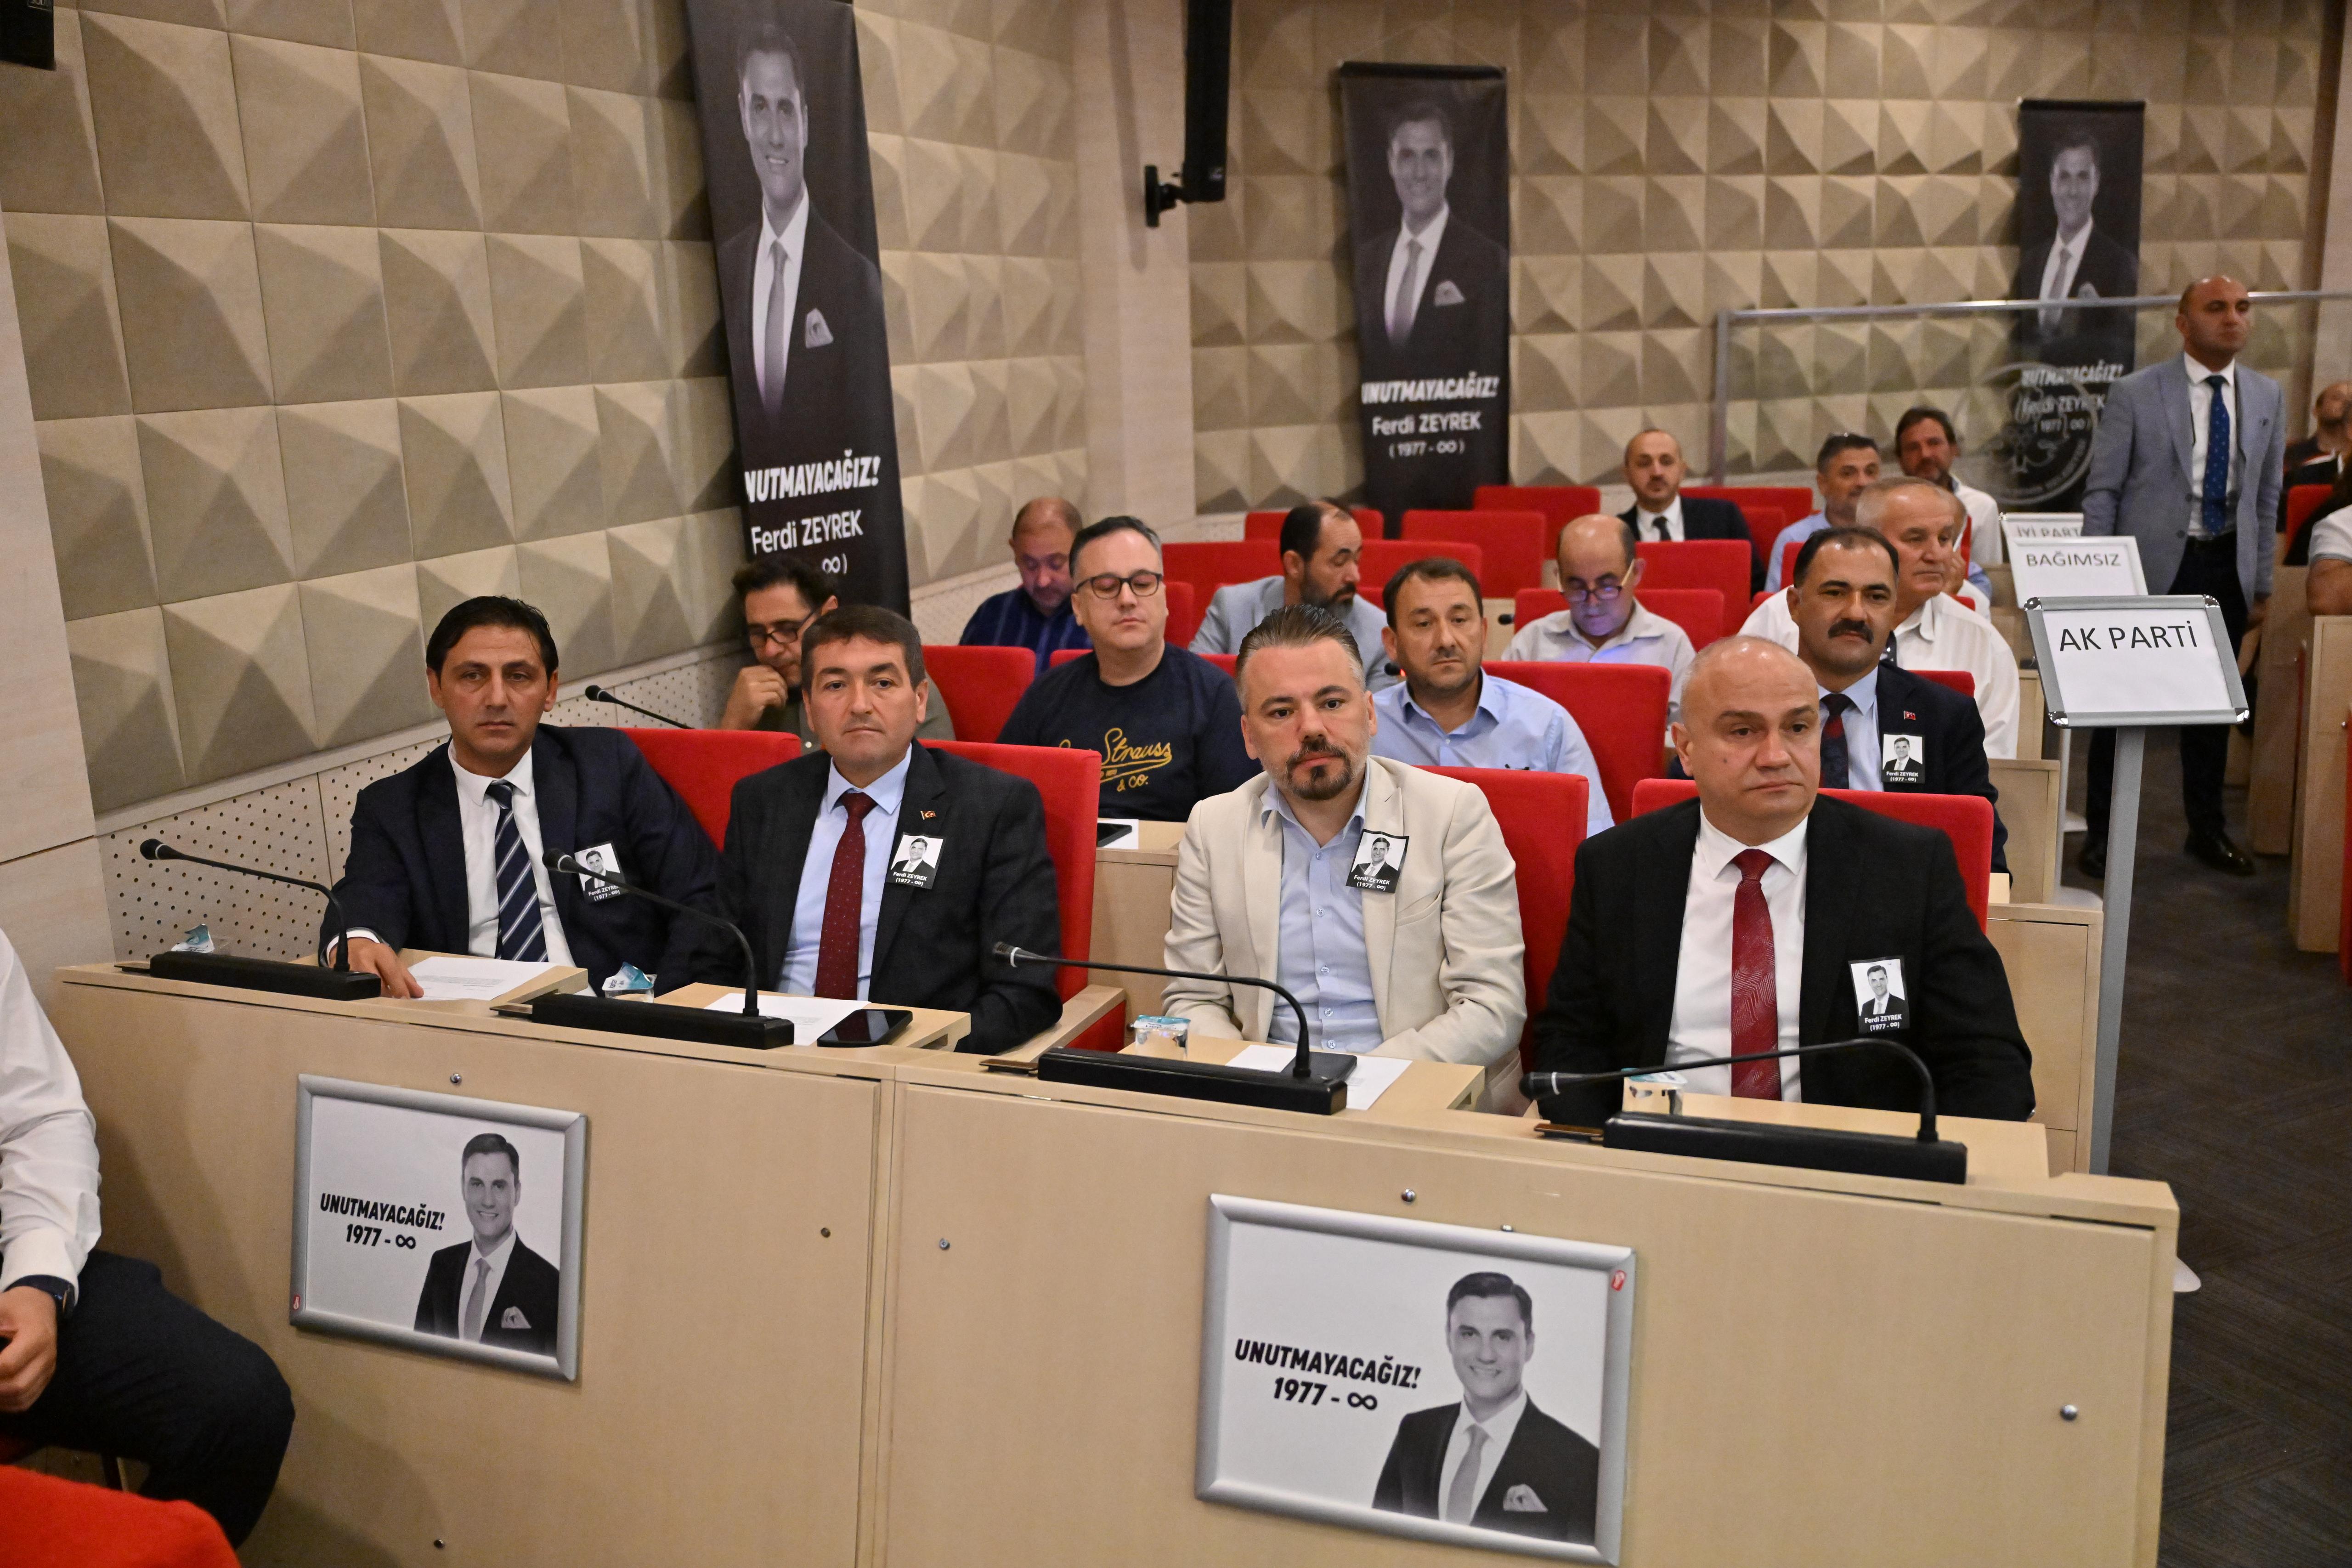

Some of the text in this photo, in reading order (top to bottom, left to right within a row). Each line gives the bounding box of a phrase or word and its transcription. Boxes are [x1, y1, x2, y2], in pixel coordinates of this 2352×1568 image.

[1361, 371, 1500, 404] UNUTMAYACAĞIZ!
[1372, 411, 1481, 436] Ferdi ZEYREK
[744, 448, 881, 503] NUTMAYACAĞIZ!
[751, 510, 864, 555] Ferdi ZEYREK
[2041, 527, 2080, 537] PART
[2026, 550, 2121, 567] BAĞIMSIZ
[2059, 620, 2198, 651] AK PARTİ
[1101, 727, 1172, 765] Strauss
[907, 873, 928, 881] ZEYREK
[320, 1193, 445, 1230] UNUTMAYACAĞIZ!
[346, 1223, 382, 1246] 1977
[1234, 1339, 1421, 1389] UNUTMAYACAĞIZ!
[1274, 1377, 1327, 1405] 1977
